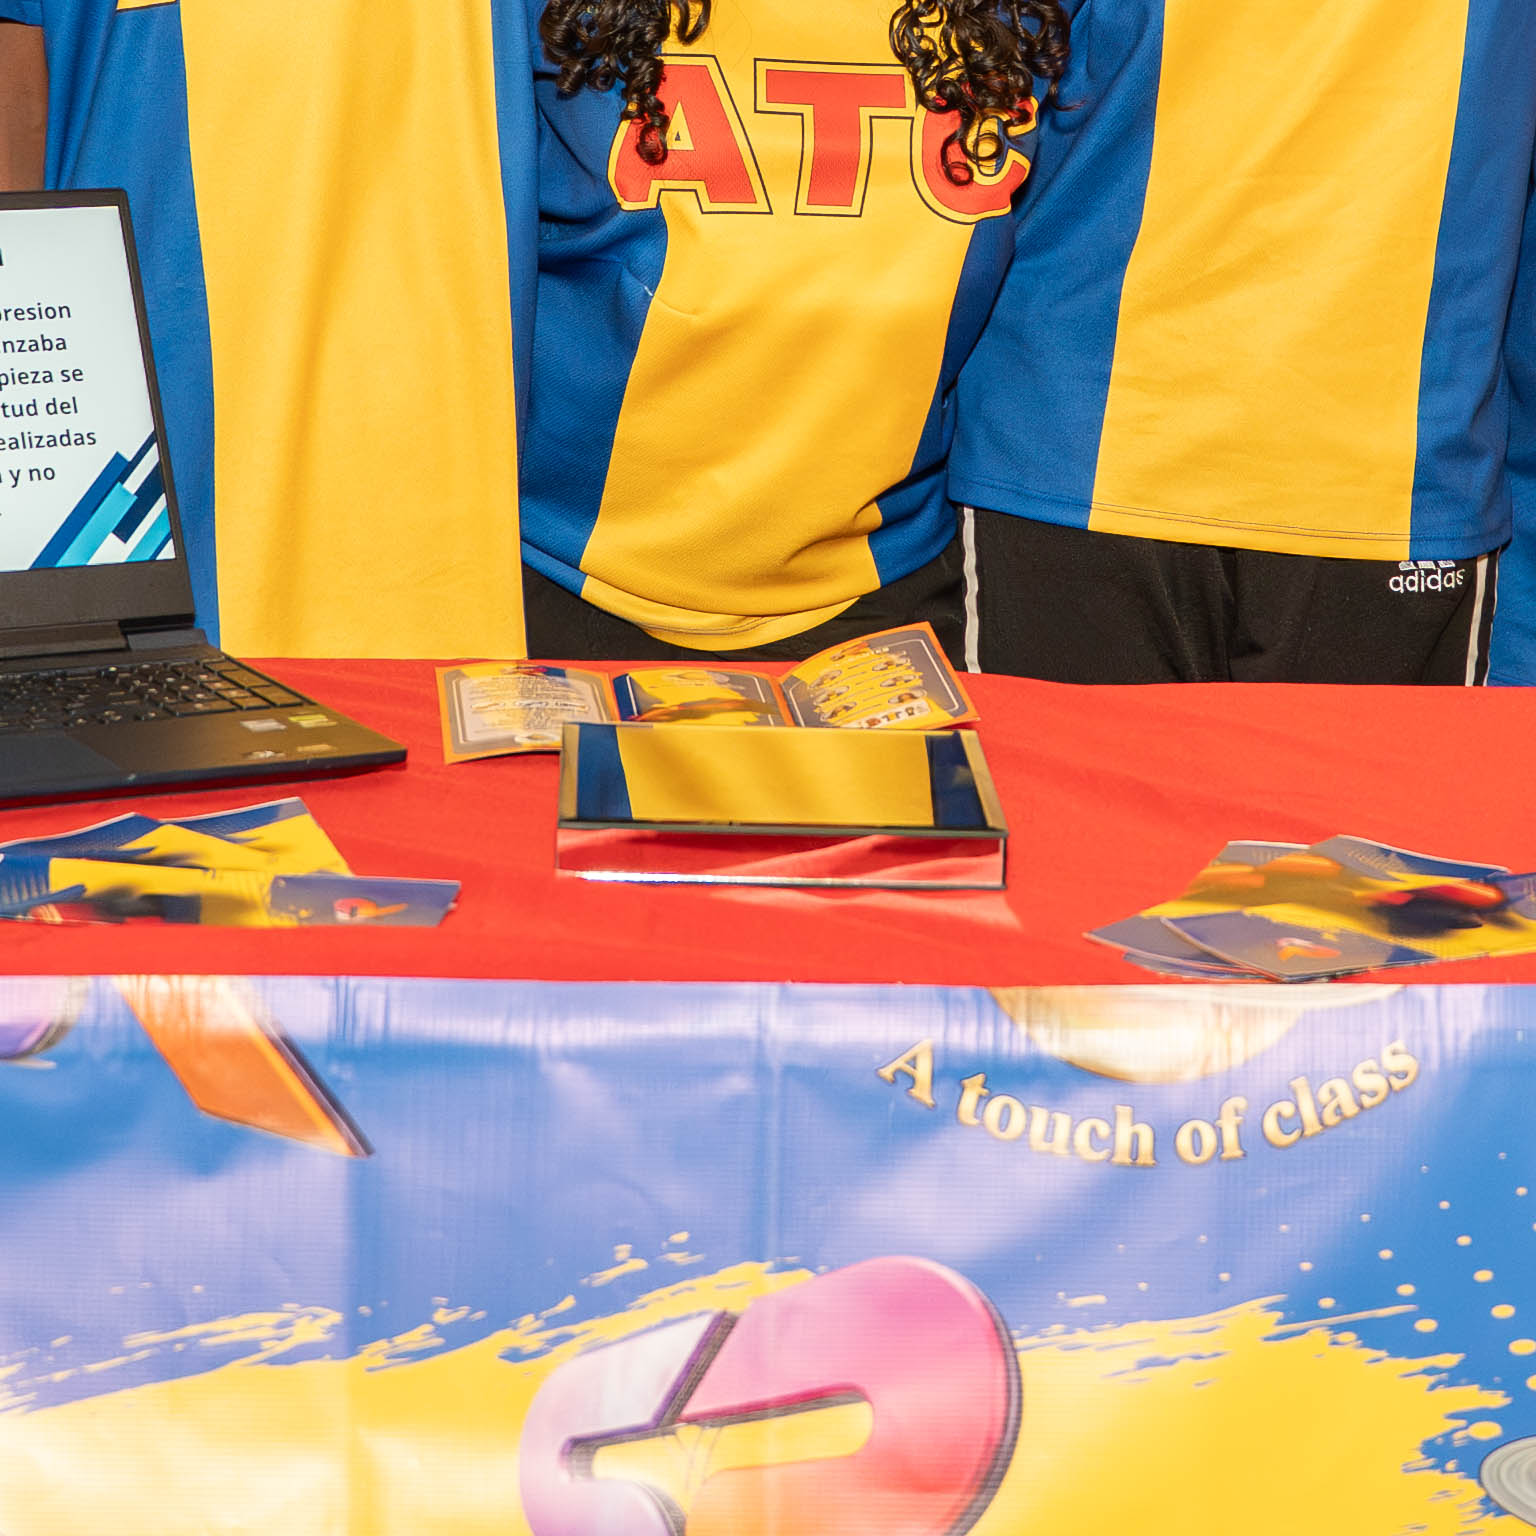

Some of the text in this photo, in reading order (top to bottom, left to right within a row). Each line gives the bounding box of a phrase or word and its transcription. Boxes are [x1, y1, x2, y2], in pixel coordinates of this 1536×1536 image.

[606, 53, 1042, 227] ATC
[60, 368, 84, 383] se
[45, 396, 78, 416] del
[8, 469, 21, 489] y
[28, 467, 56, 482] no
[1388, 568, 1465, 595] adidas
[876, 1037, 1423, 1168] A touch of class
